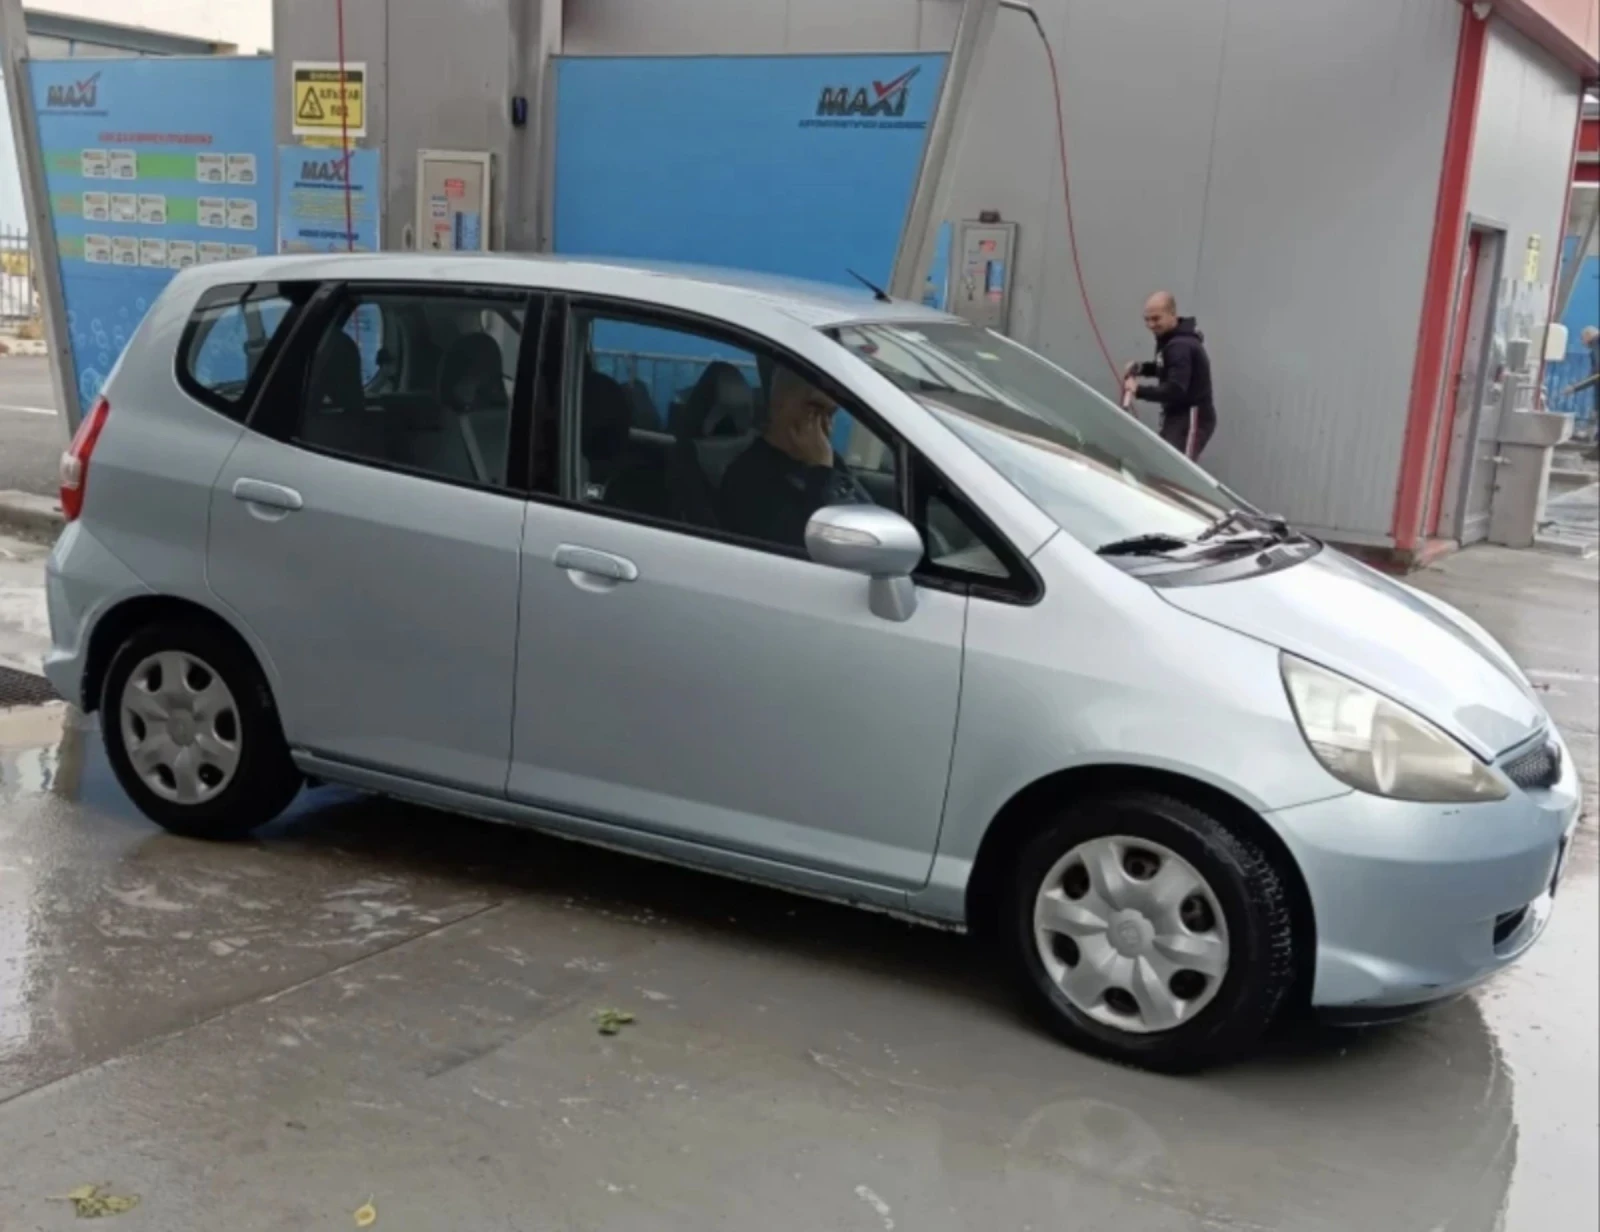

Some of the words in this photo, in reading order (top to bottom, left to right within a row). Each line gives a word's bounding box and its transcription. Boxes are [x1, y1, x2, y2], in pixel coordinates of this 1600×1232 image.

[47, 76, 100, 107] MAXI
[816, 73, 916, 117] MAXI
[300, 158, 350, 180] MAX
